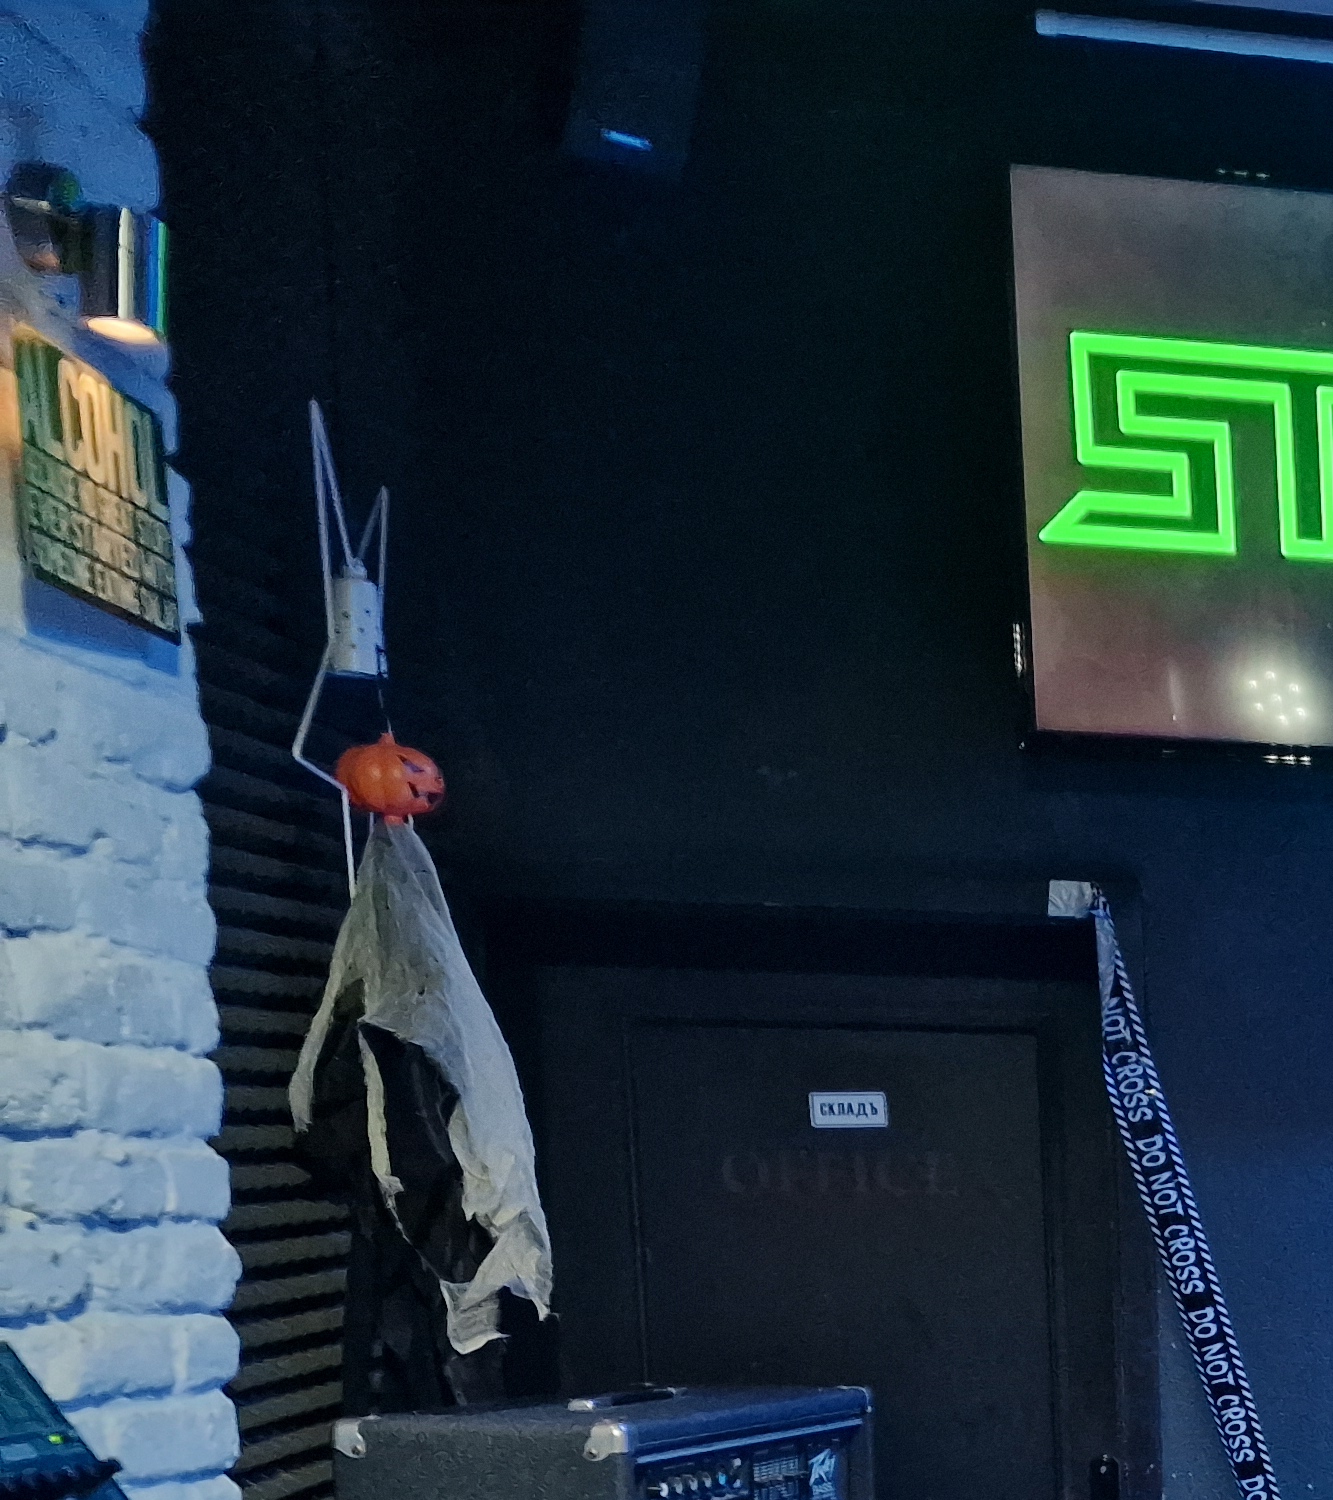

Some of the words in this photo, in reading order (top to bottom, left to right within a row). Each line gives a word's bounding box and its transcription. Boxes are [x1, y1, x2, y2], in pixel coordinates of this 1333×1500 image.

[819, 1101, 878, 1118] СКЛАДЪ
[1111, 1052, 1153, 1123] CROSS
[1135, 1134, 1167, 1167] DO
[1149, 1171, 1184, 1216] NOT
[1164, 1224, 1205, 1295] CROSS
[1188, 1306, 1217, 1338] DO
[1201, 1342, 1235, 1385] NOT
[1216, 1395, 1255, 1463] CROSS
